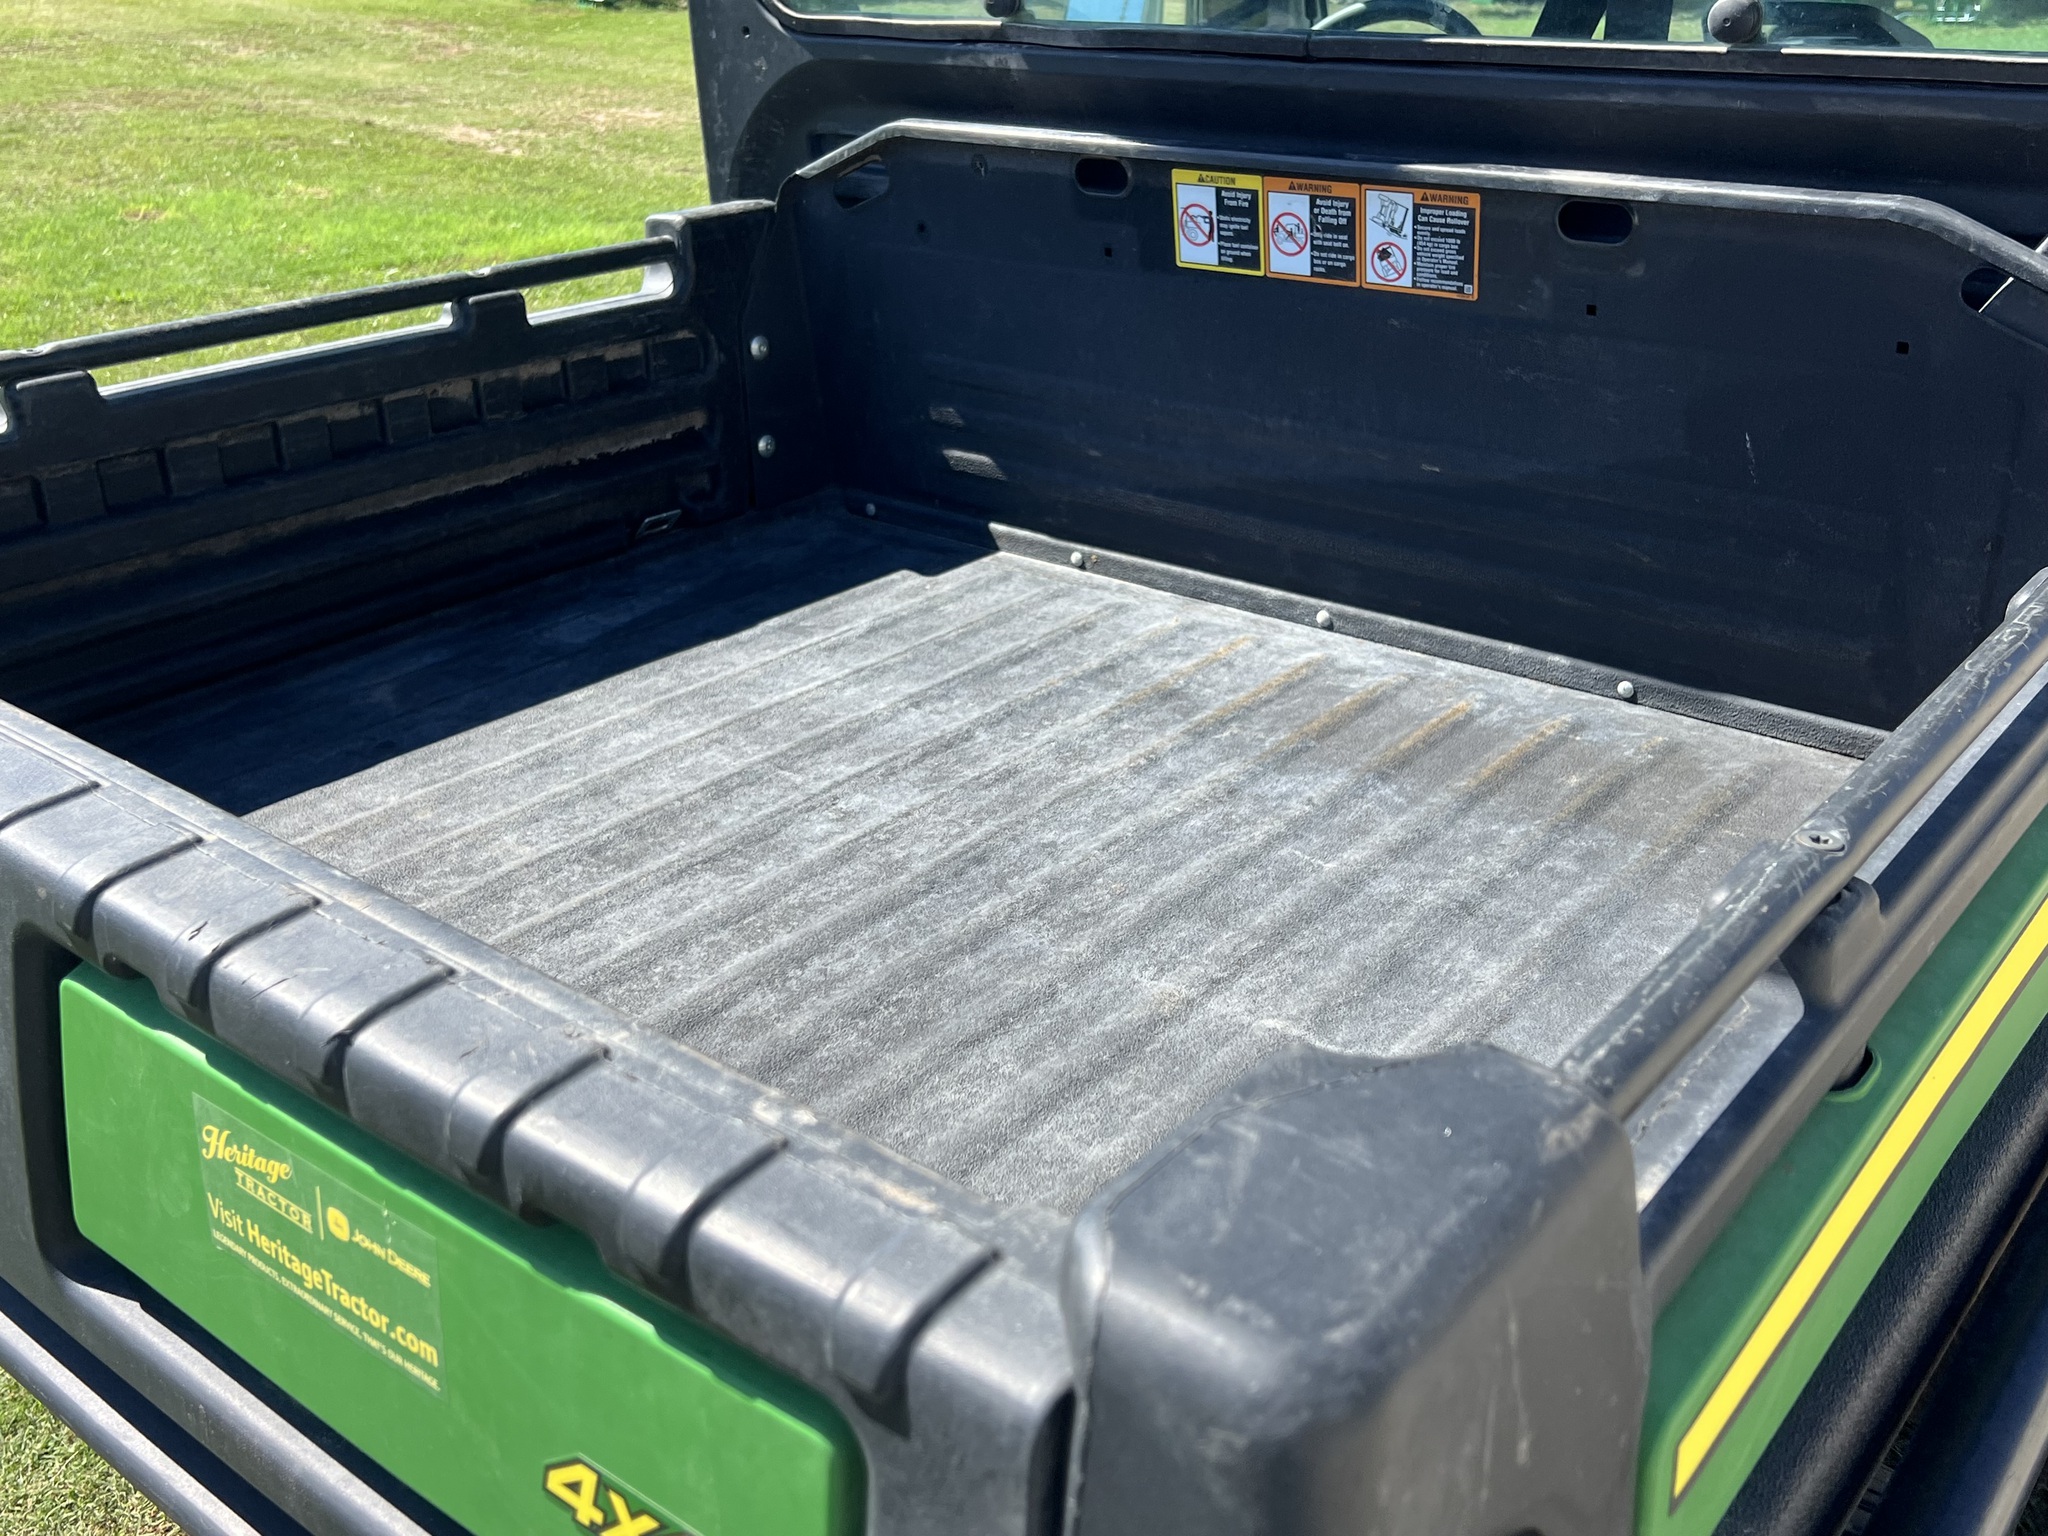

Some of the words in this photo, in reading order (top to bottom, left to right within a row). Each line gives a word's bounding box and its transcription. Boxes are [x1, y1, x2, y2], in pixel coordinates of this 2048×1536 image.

[1204, 175, 1236, 186] CAUTION
[1296, 182, 1332, 194] WARNING
[1221, 190, 1236, 198] Avoid
[1236, 192, 1252, 200] Injury
[1430, 193, 1469, 205] WARNING
[1333, 200, 1349, 209] Injury
[1338, 209, 1351, 217] from
[1420, 207, 1444, 216] Improper
[1446, 210, 1467, 219] Loading
[1318, 216, 1337, 225] Falling
[1447, 217, 1470, 226] Rollover
[202, 1125, 292, 1183] Heritage
[236, 1169, 313, 1231] TRACTOR
[352, 1228, 387, 1260] JOHN
[388, 1247, 432, 1288] DEERE
[208, 1192, 244, 1238] Visit
[246, 1218, 438, 1368] HeritageTractor.com
[544, 1460, 678, 1536] 4X
